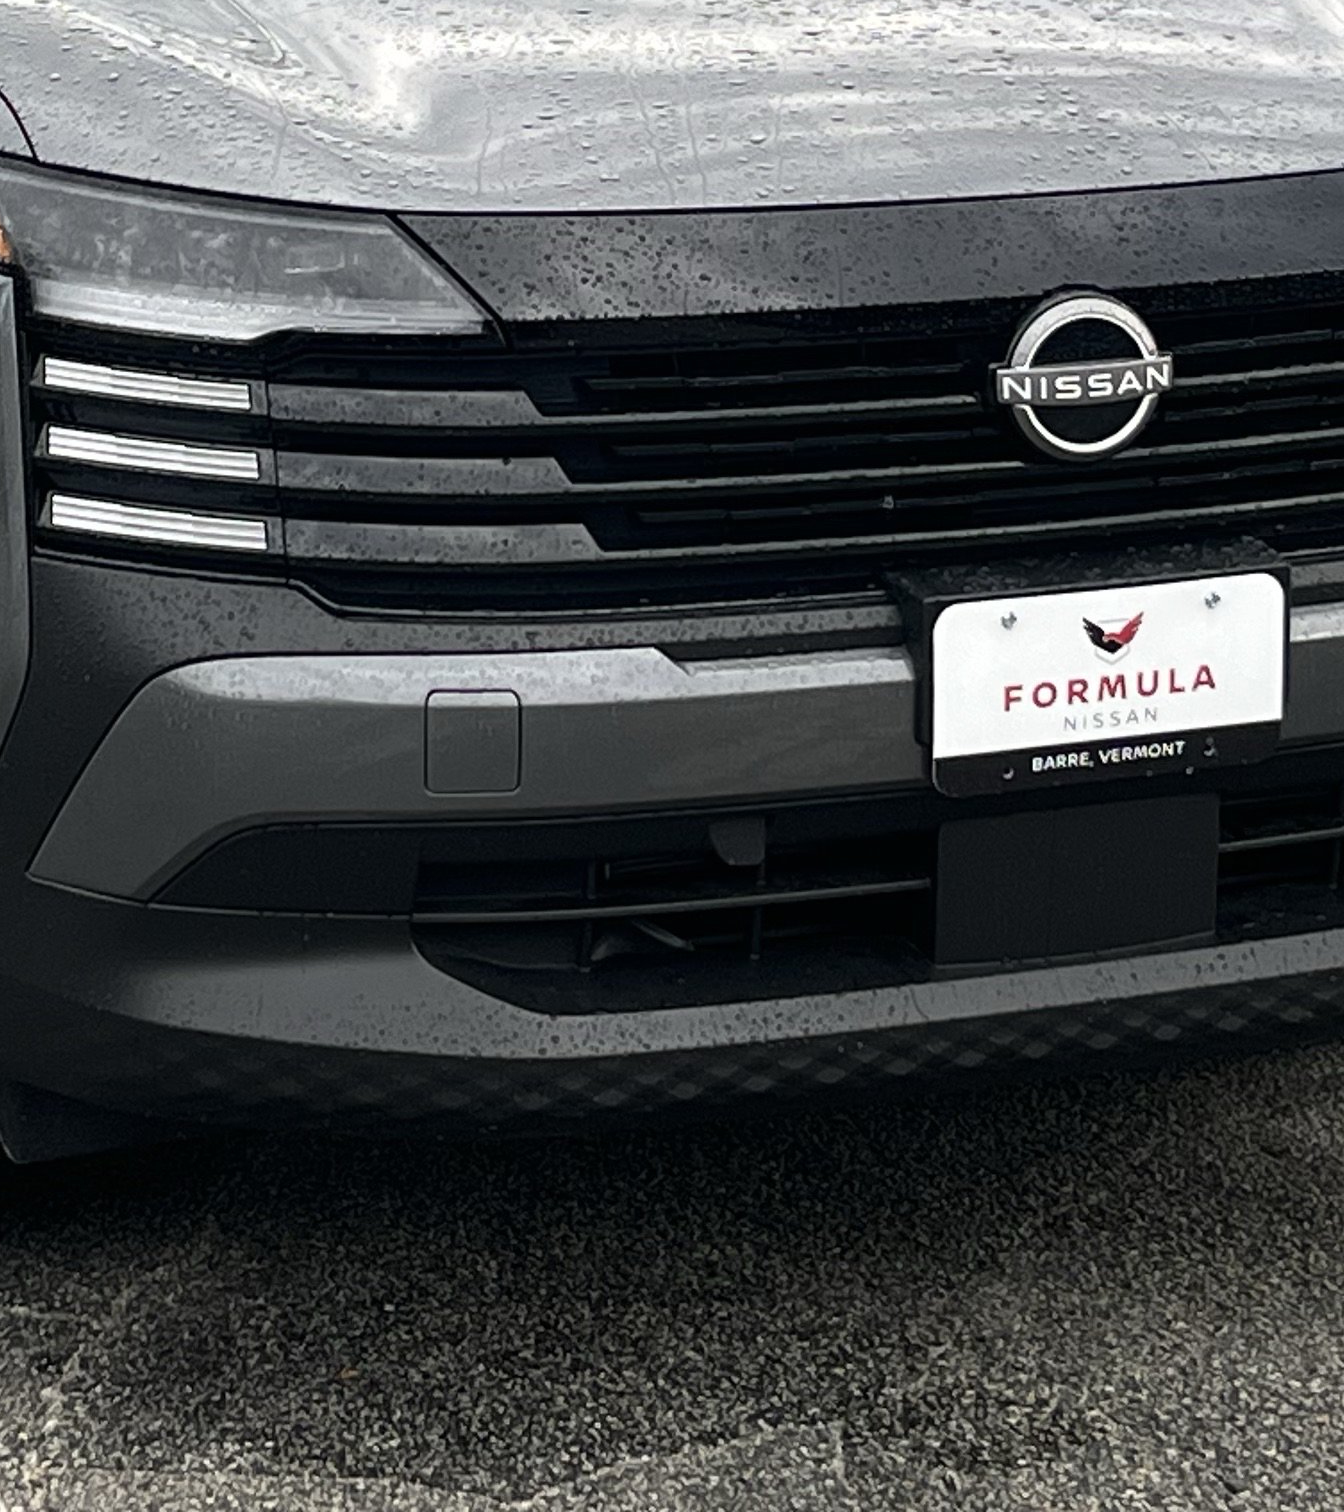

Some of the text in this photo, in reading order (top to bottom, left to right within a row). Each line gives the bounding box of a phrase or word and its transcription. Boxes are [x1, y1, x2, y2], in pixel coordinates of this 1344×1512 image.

[1002, 363, 1169, 400] NISSAN
[1004, 664, 1216, 712] FORMULA
[1064, 707, 1158, 731] NISSAN
[1032, 741, 1186, 772] BARRE, VERMONT
